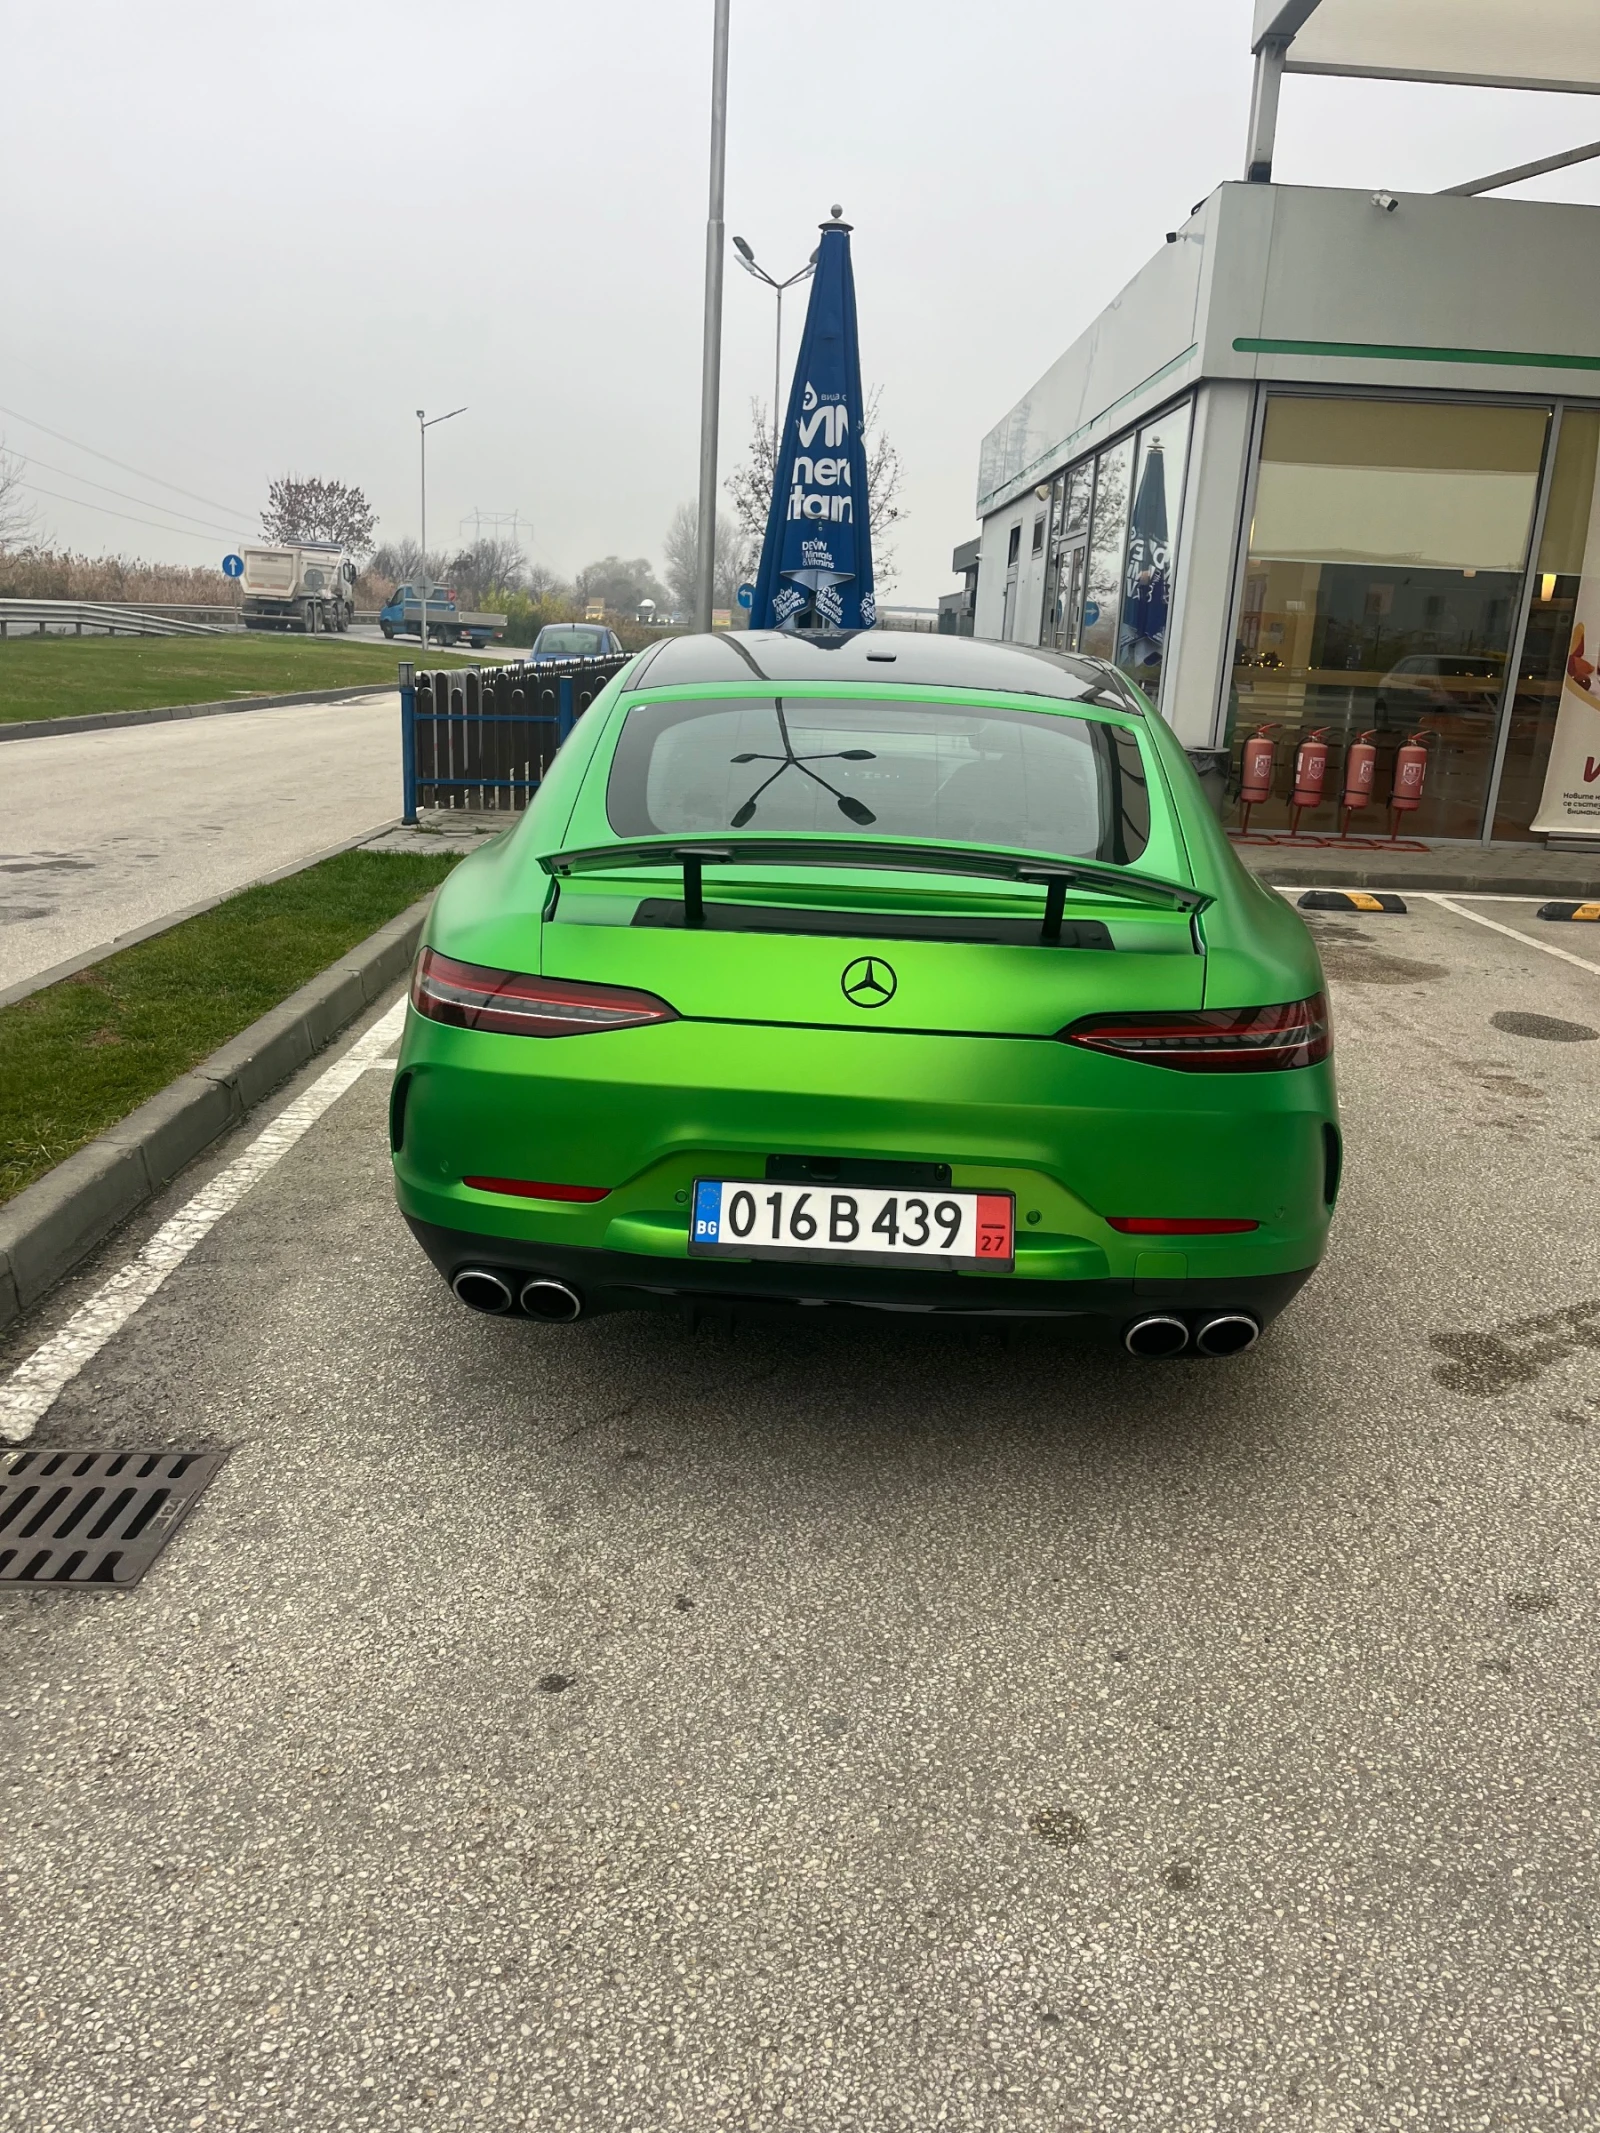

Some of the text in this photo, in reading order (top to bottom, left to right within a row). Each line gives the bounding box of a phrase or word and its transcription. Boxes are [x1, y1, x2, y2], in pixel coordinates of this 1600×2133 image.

[802, 541, 828, 551] DEVIN
[696, 1220, 718, 1235] BG
[981, 1235, 1005, 1252] 27
